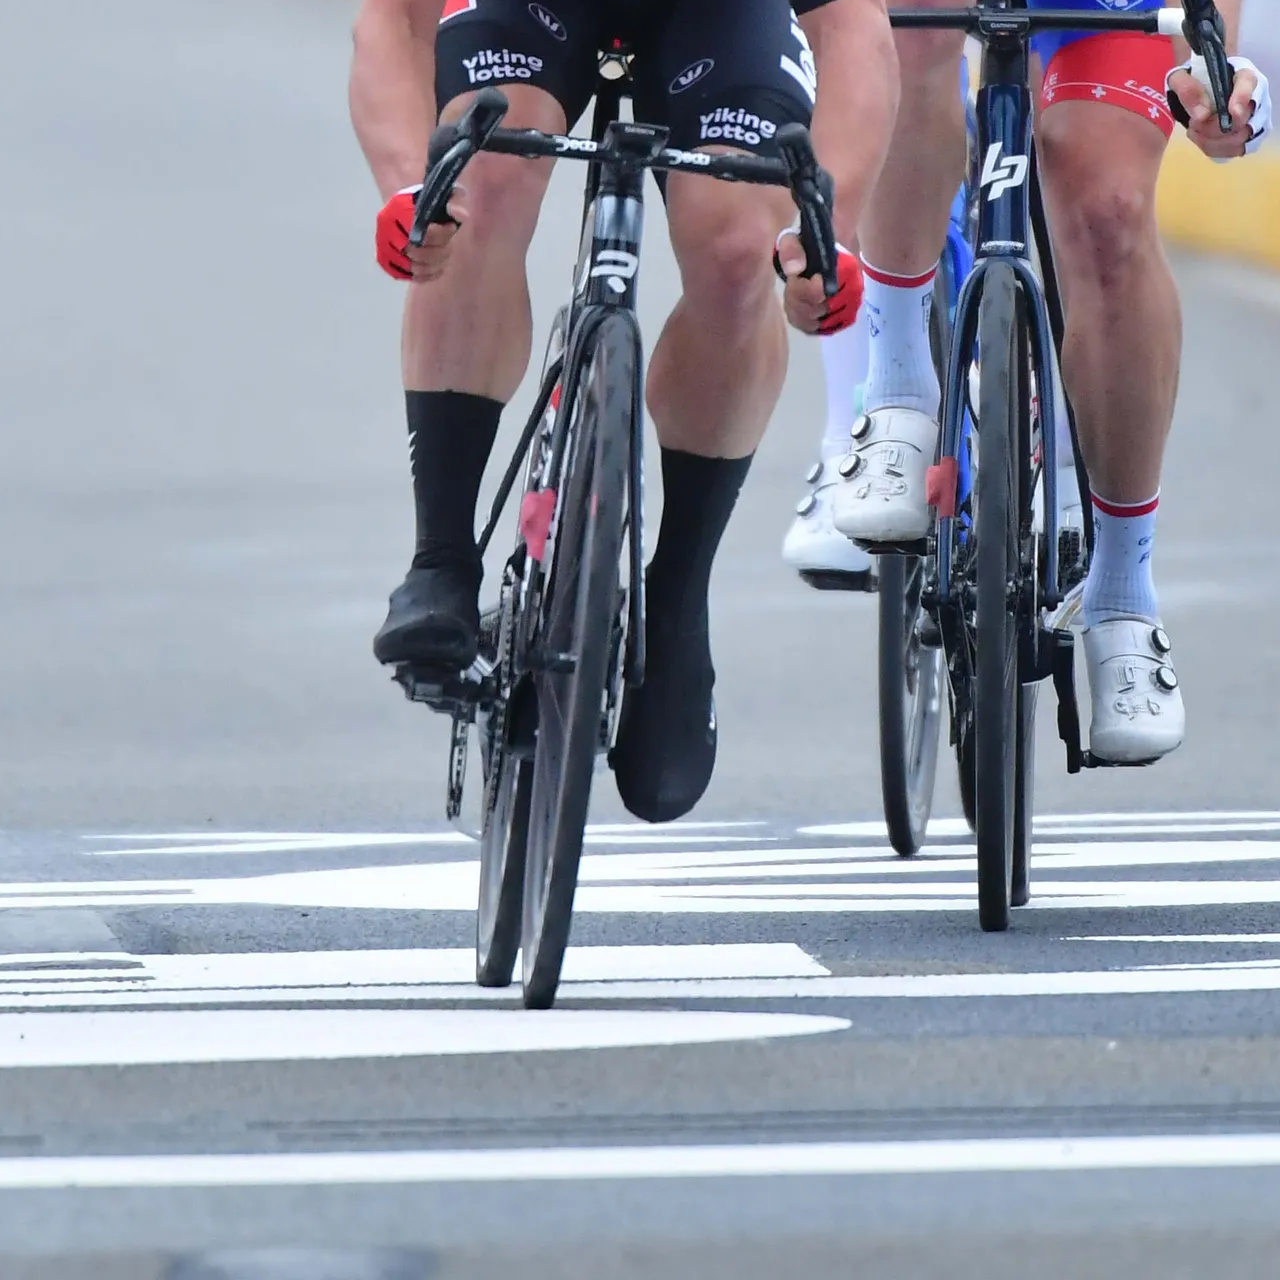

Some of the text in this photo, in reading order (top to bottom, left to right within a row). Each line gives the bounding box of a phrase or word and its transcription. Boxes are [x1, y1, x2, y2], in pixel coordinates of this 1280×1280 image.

[462, 48, 543, 72] viking
[468, 65, 532, 84] lotto
[699, 107, 777, 139] viking
[700, 123, 761, 146] lotto
